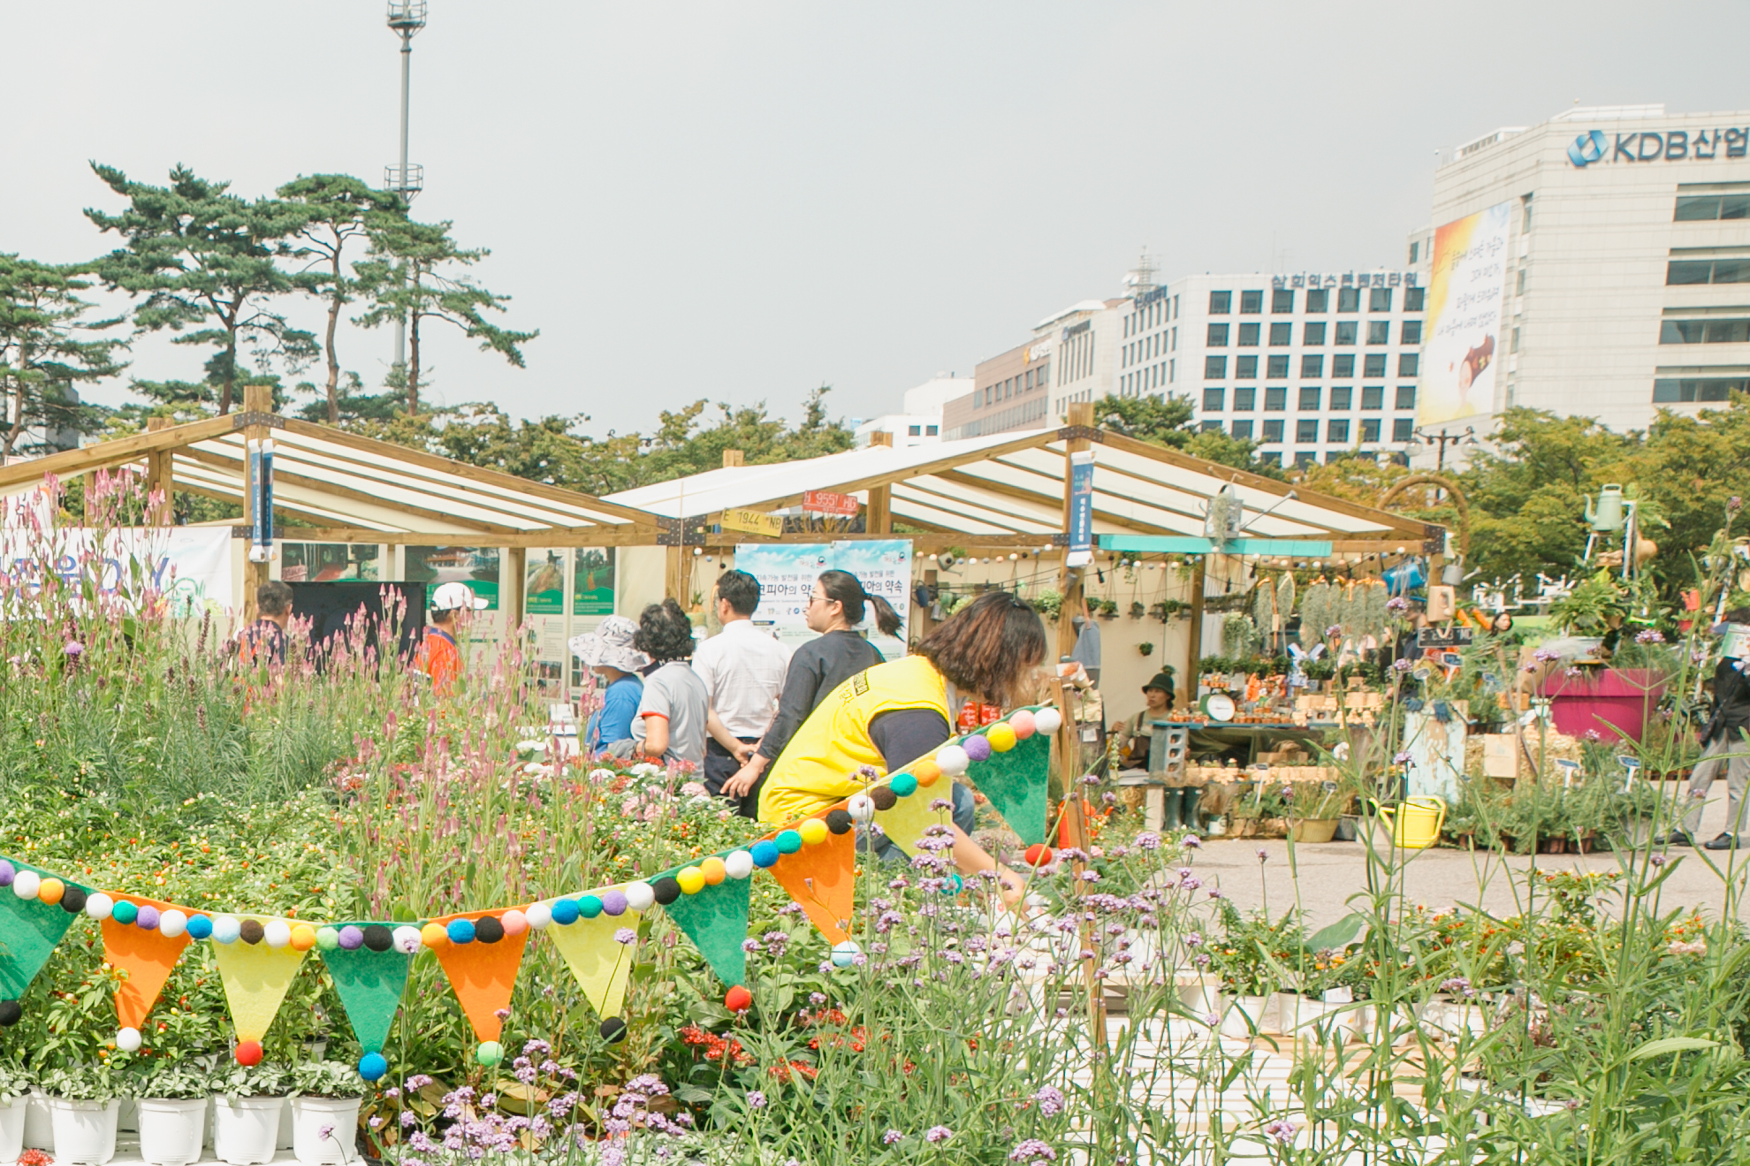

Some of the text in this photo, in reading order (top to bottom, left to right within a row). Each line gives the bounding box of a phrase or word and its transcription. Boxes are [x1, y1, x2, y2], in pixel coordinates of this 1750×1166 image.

[816, 492, 838, 506] 9551
[843, 496, 857, 510] HG
[737, 511, 759, 526] 1944
[884, 580, 903, 594] 약속
